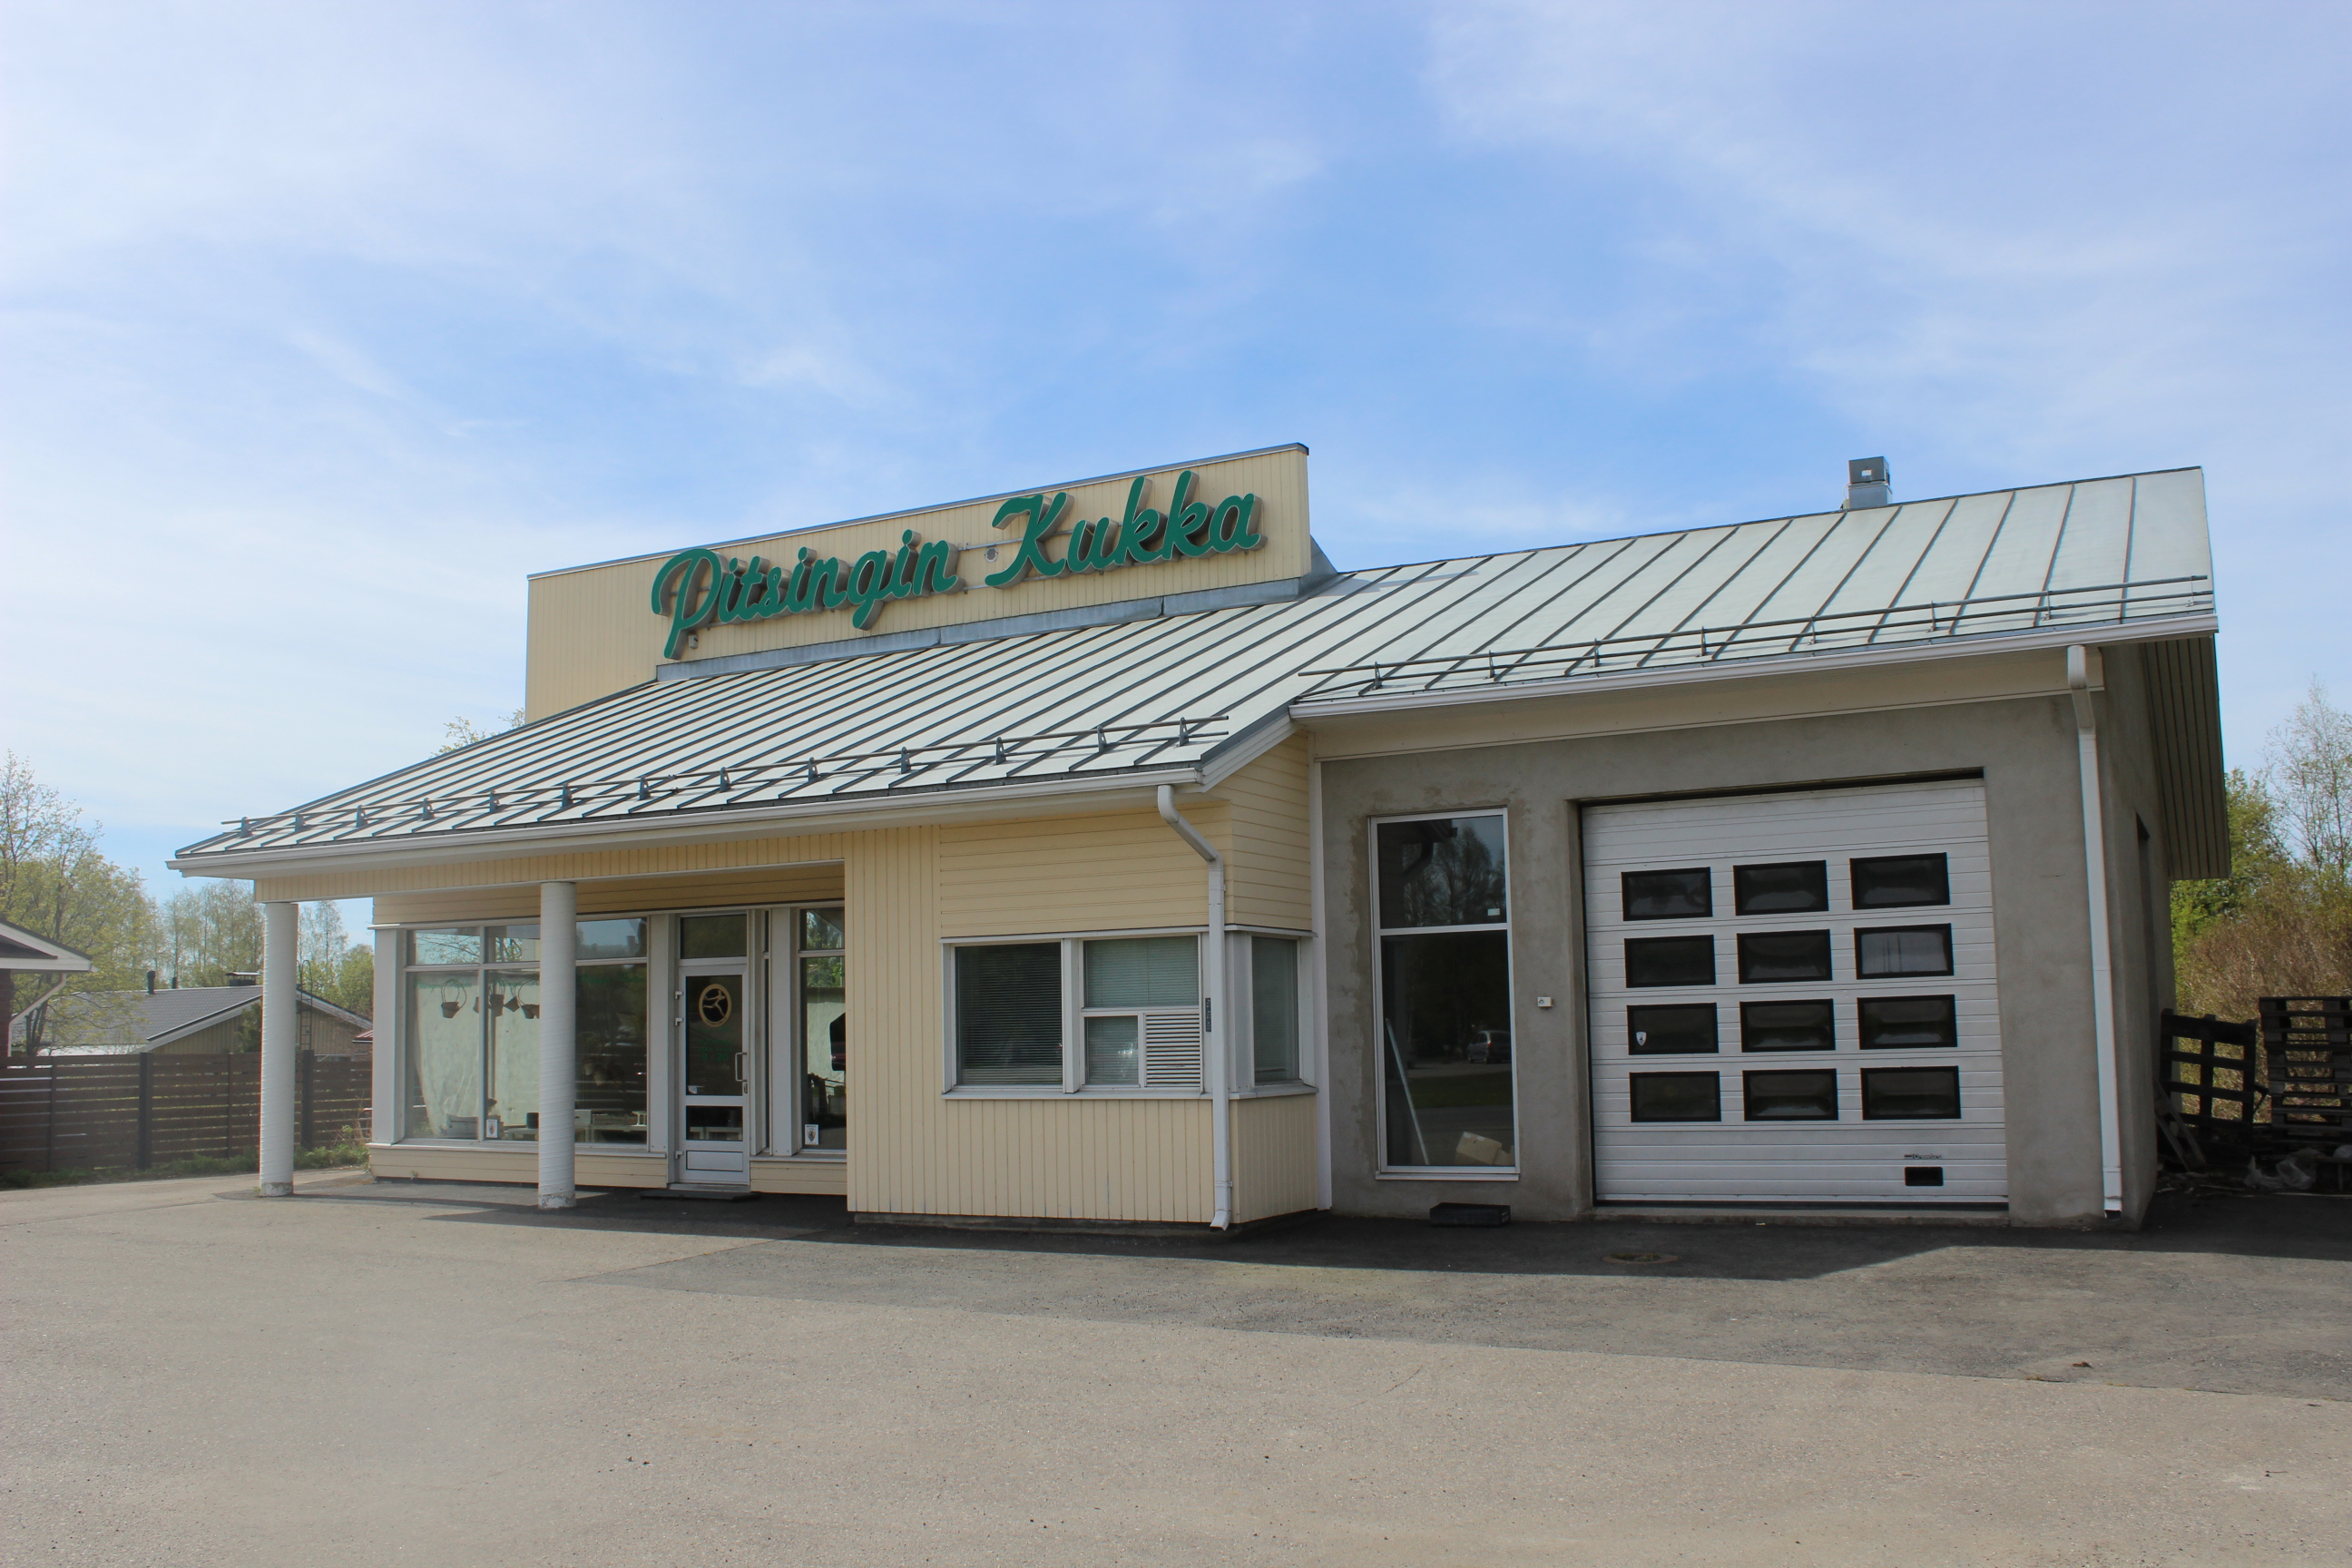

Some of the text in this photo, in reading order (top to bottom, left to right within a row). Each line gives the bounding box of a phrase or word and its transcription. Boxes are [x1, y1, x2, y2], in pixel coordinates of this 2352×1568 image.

[651, 469, 1267, 660] Pitsingin Kukka
[701, 1053, 708, 1062] 9
[716, 1053, 728, 1062] 20
